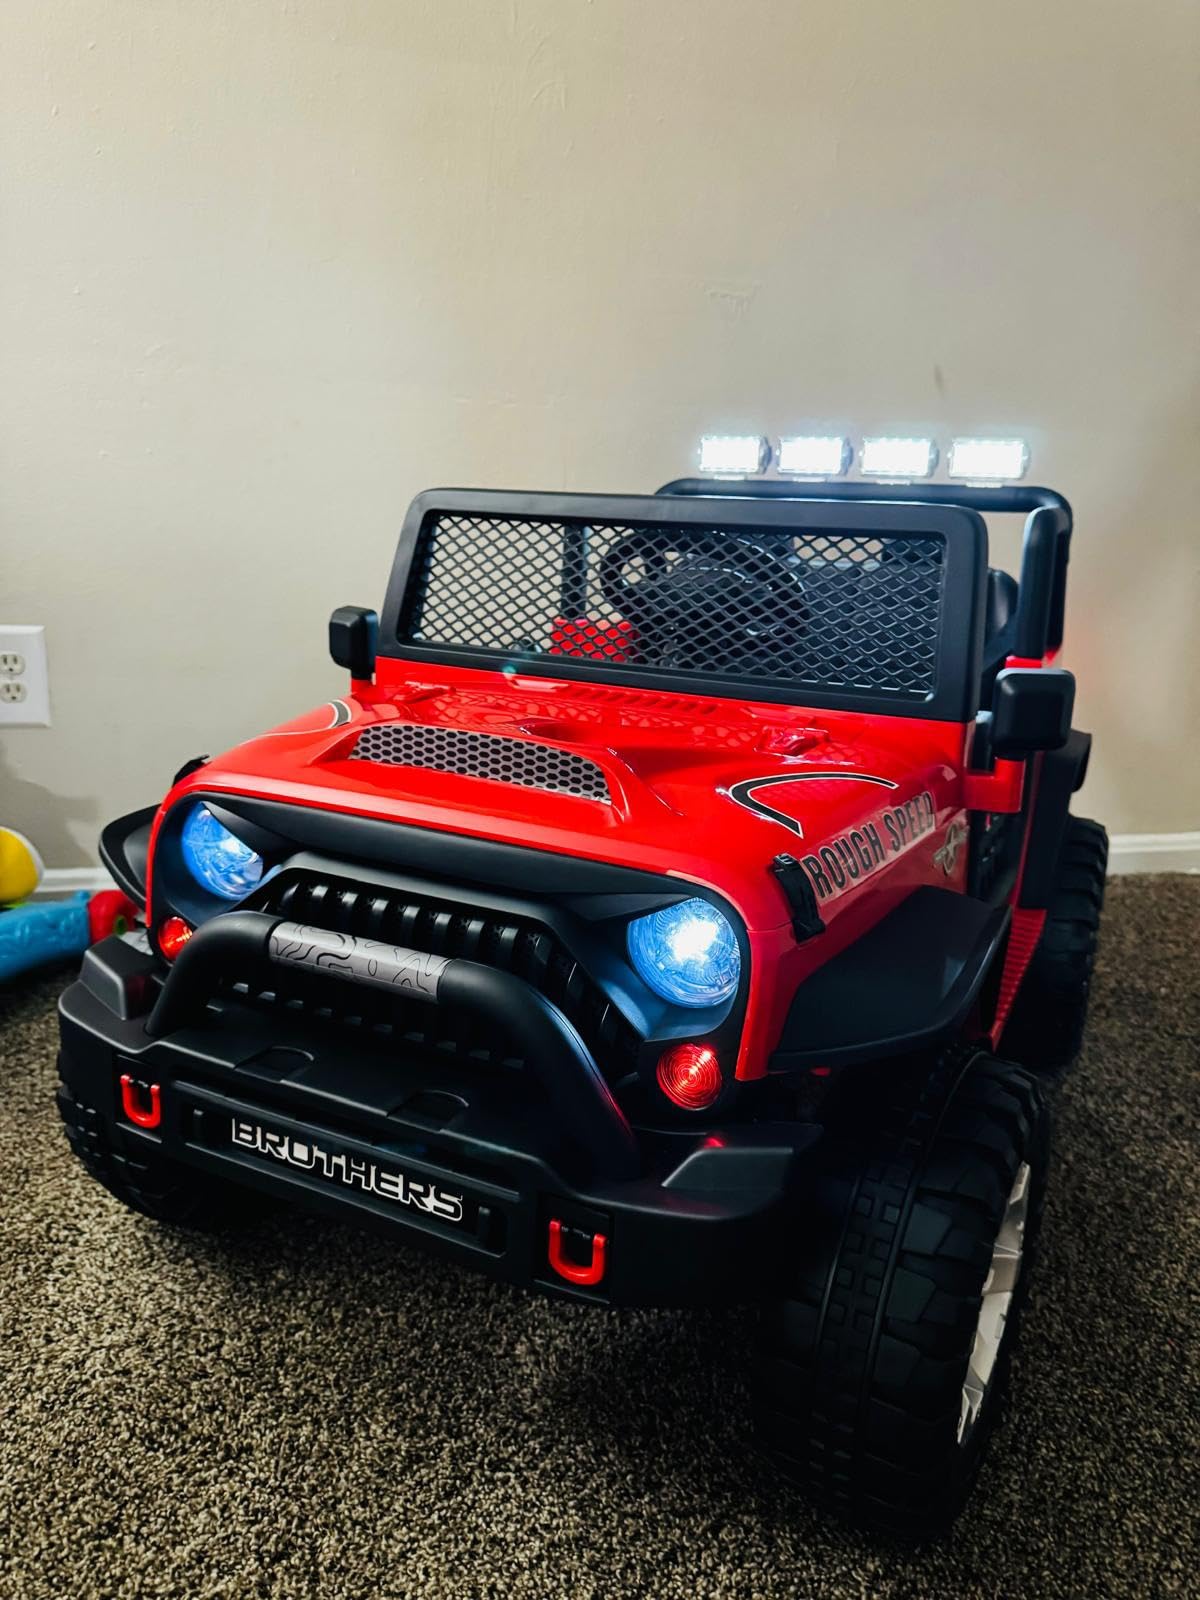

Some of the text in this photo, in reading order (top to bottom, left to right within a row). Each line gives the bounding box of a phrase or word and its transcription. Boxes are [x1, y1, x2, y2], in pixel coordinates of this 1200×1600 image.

[801, 791, 936, 899] ROUGH SPEED
[231, 1118, 463, 1221] BROTHERS
